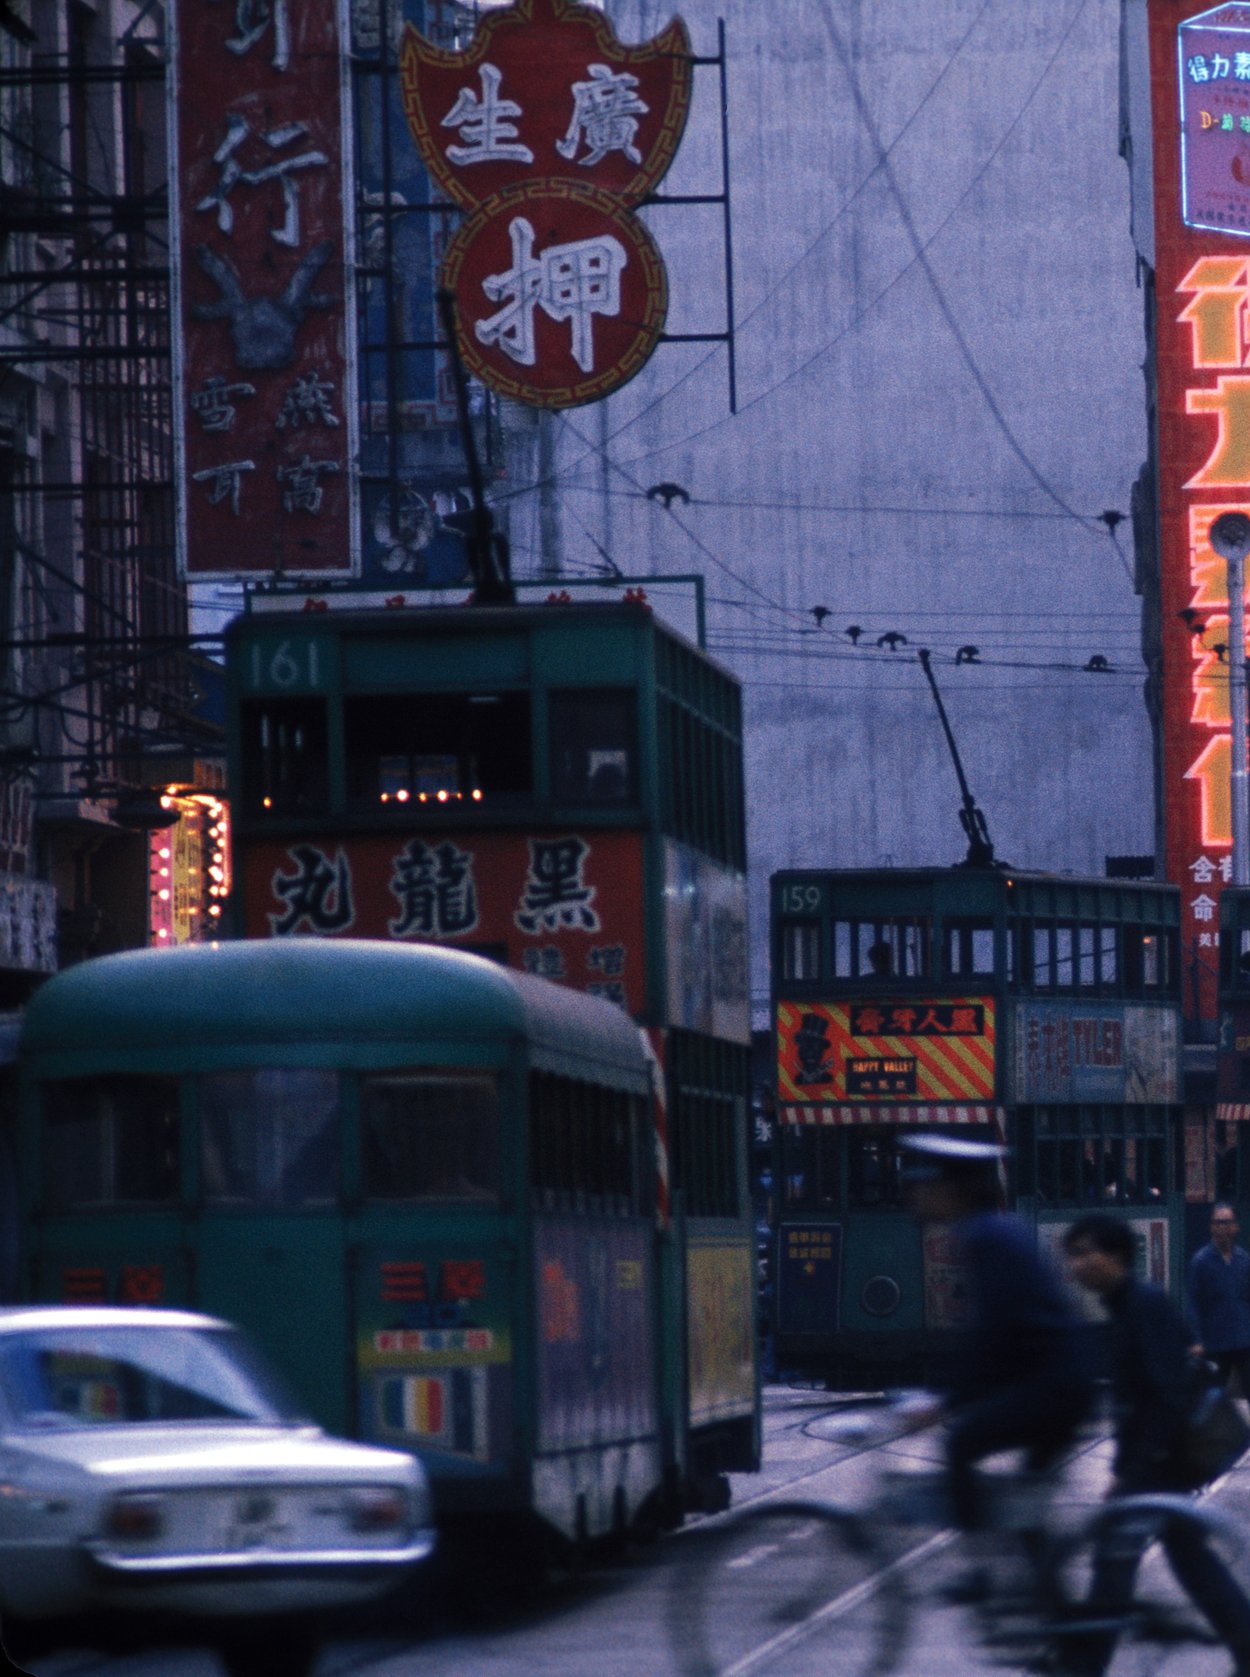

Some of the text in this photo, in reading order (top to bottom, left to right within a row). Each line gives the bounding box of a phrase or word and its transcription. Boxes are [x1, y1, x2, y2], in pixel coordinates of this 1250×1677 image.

[472, 214, 629, 374] 押
[250, 639, 321, 689] 161
[781, 884, 822, 914] 159
